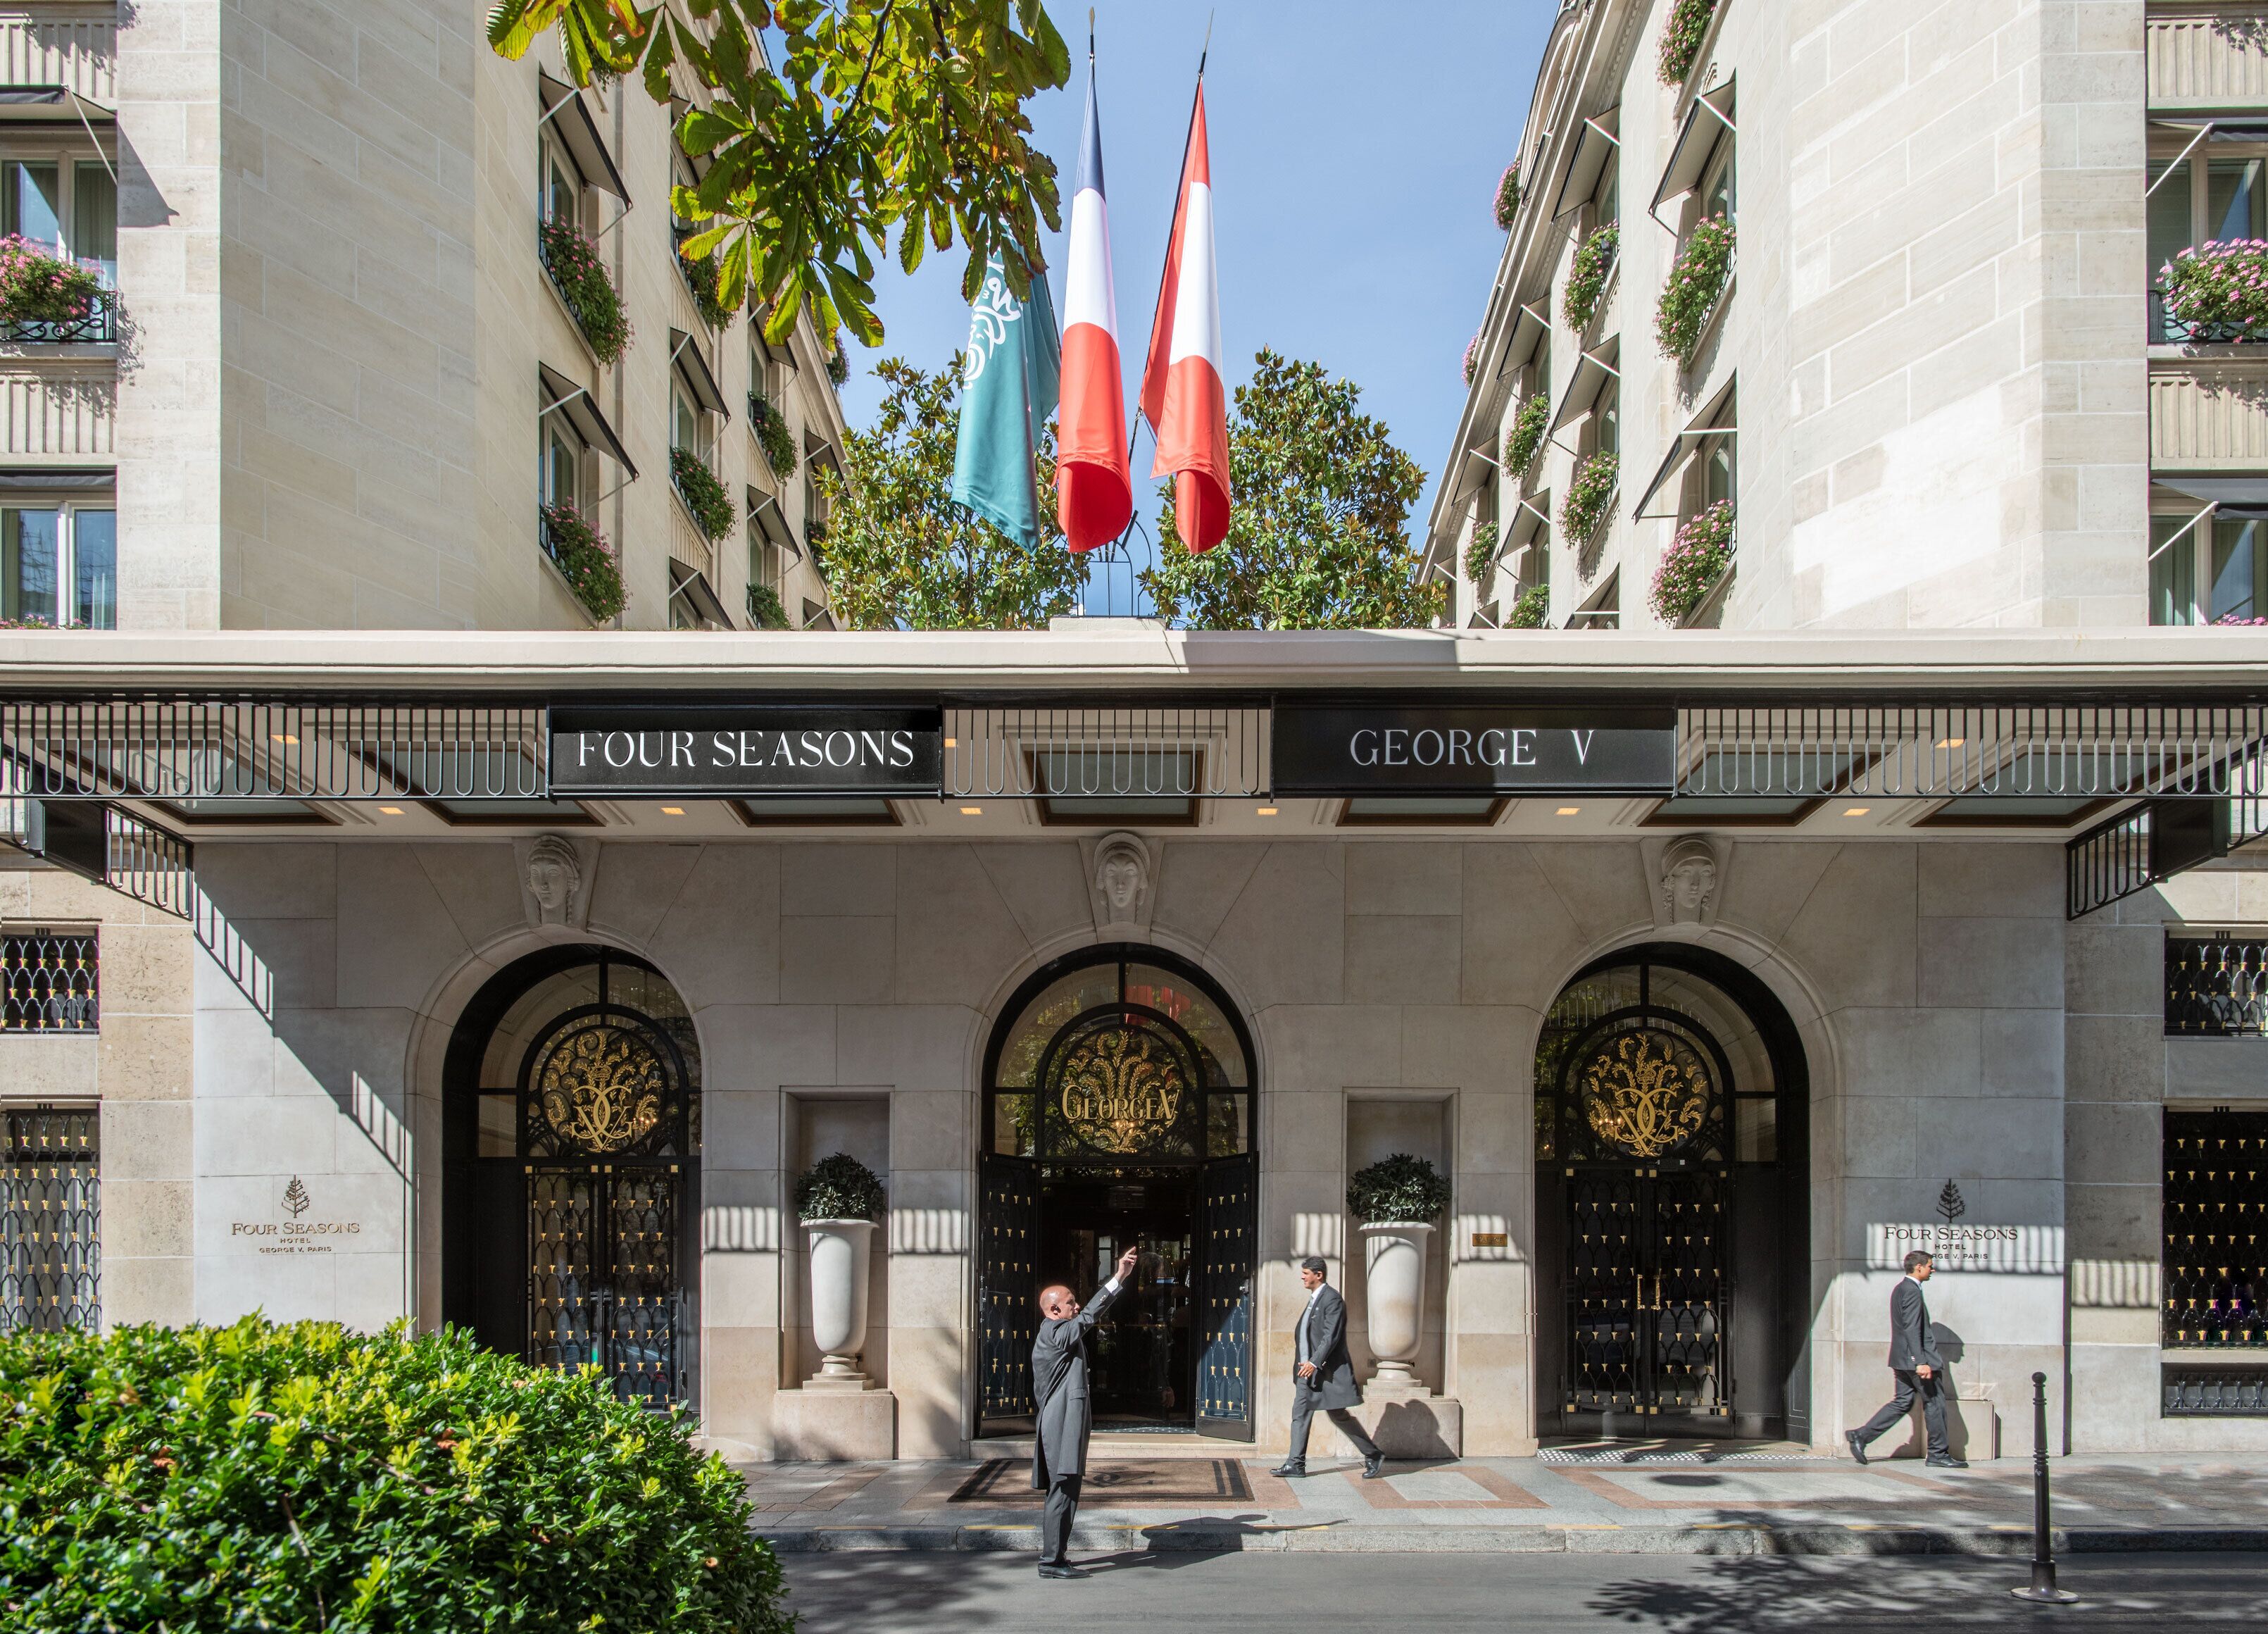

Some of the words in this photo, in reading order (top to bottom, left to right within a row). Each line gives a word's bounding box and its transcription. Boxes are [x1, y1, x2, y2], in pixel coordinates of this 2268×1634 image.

[577, 729, 696, 767] FOUR
[712, 729, 914, 767] SEASONS
[1350, 729, 1536, 766] GEORGE
[1570, 729, 1595, 766] V
[232, 1223, 277, 1235] FOUR
[282, 1222, 361, 1235] SEASONS
[1884, 1226, 1932, 1240] FOUR
[1937, 1227, 2018, 1240] SEASONS
